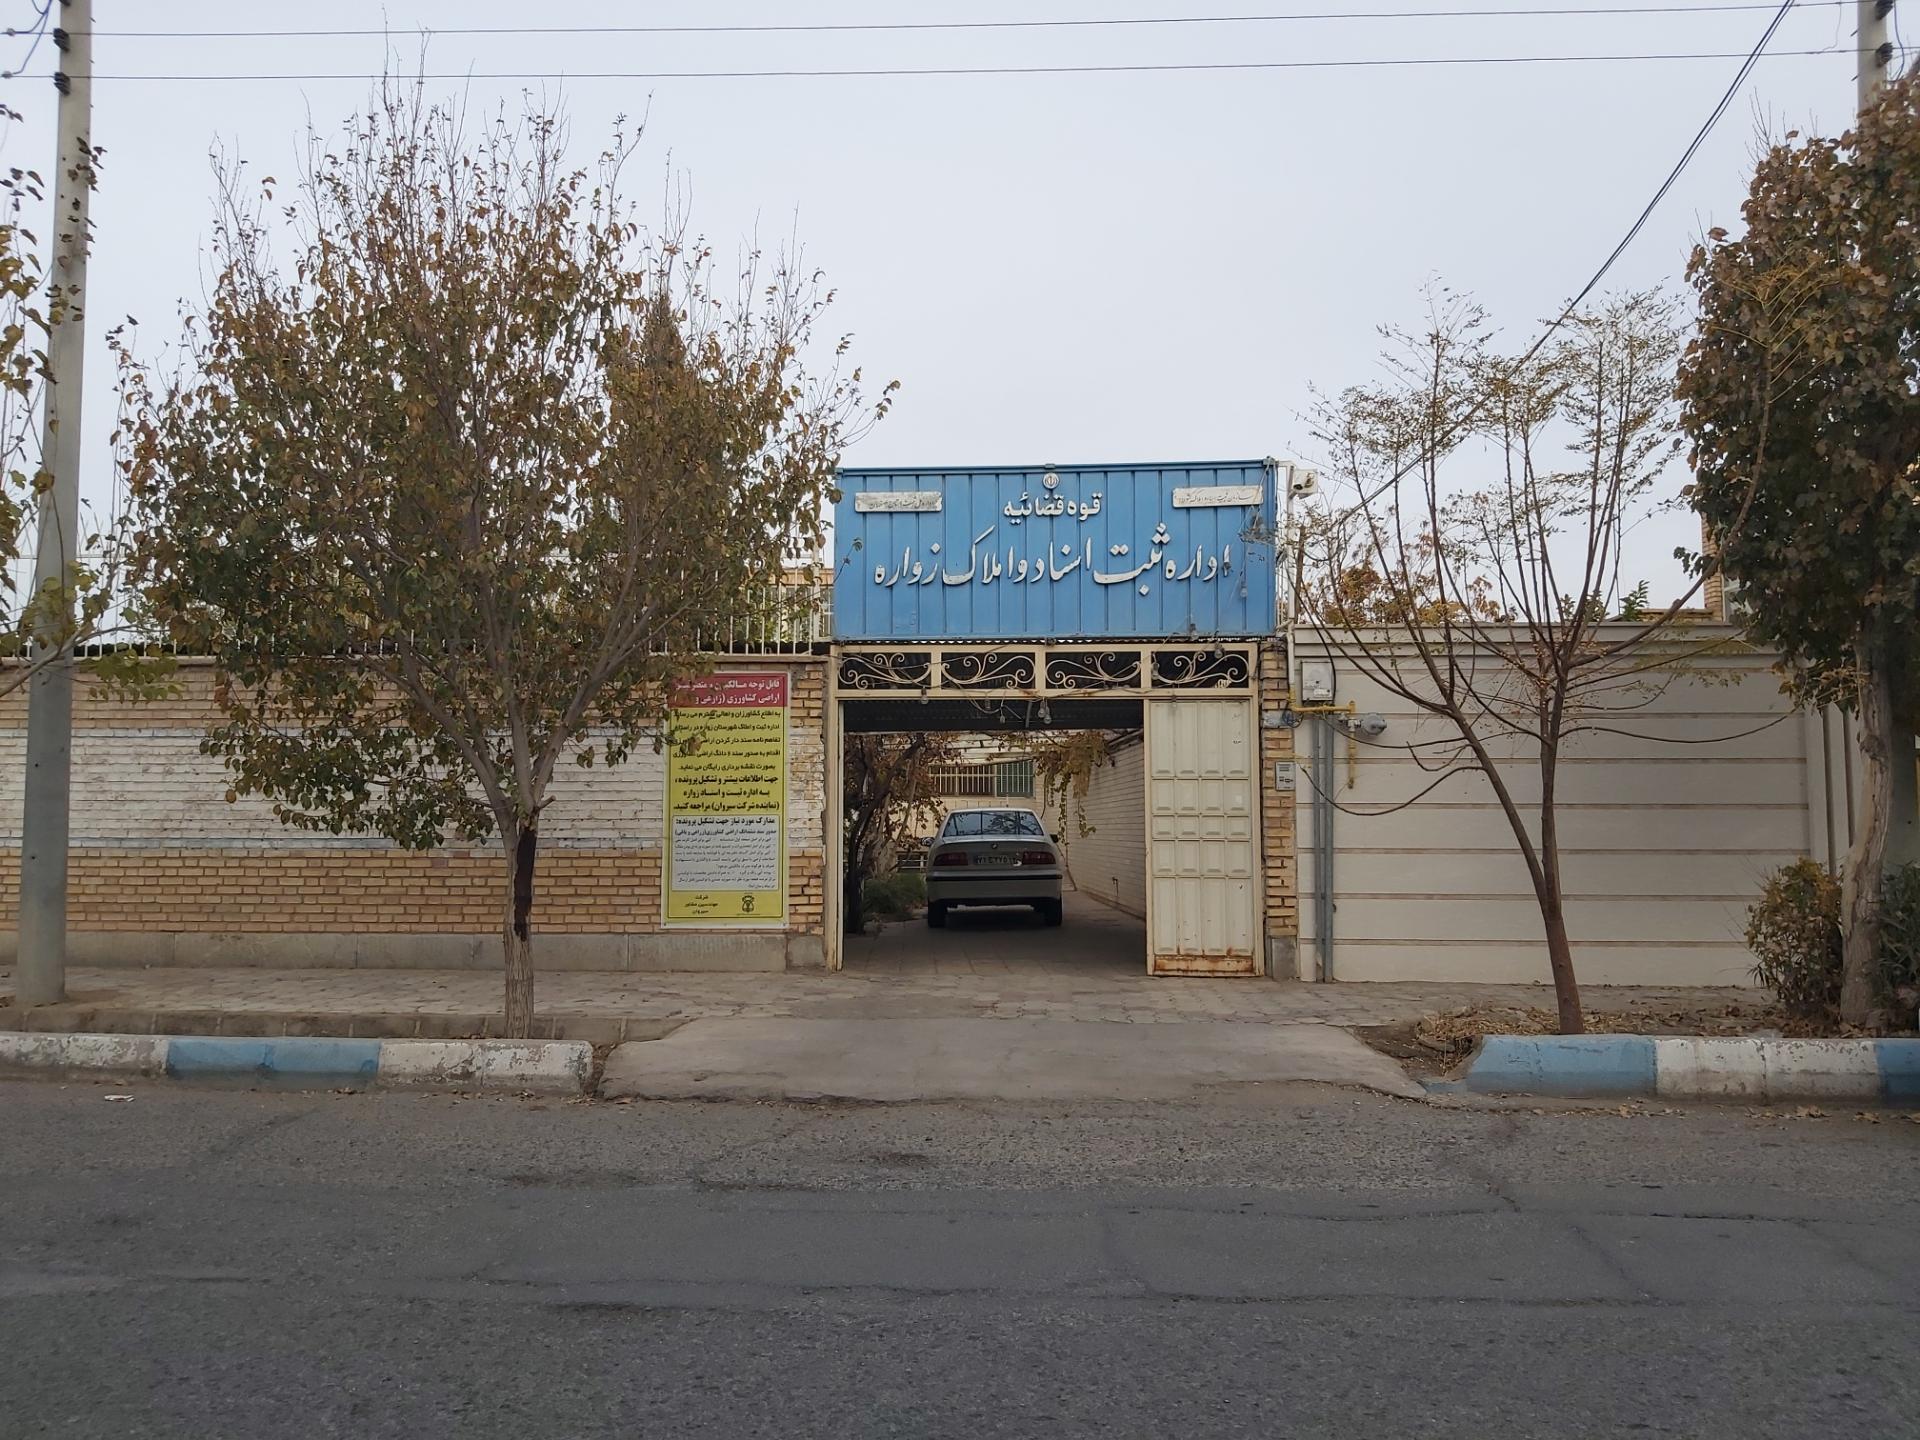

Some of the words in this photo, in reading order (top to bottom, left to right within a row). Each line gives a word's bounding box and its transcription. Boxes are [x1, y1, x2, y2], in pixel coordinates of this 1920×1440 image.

[1066, 492, 1103, 521] قوه
[874, 542, 942, 587] زواره
[941, 524, 1015, 586] املاک
[1029, 536, 1092, 584] اسناد
[1093, 522, 1172, 596] ثبت
[1164, 543, 1233, 582] اداره
[1013, 559, 1029, 584] و
[727, 693, 757, 704] کشاورزی
[748, 679, 765, 691] توجه
[758, 693, 780, 704] اراضی
[765, 679, 780, 690] قابل
